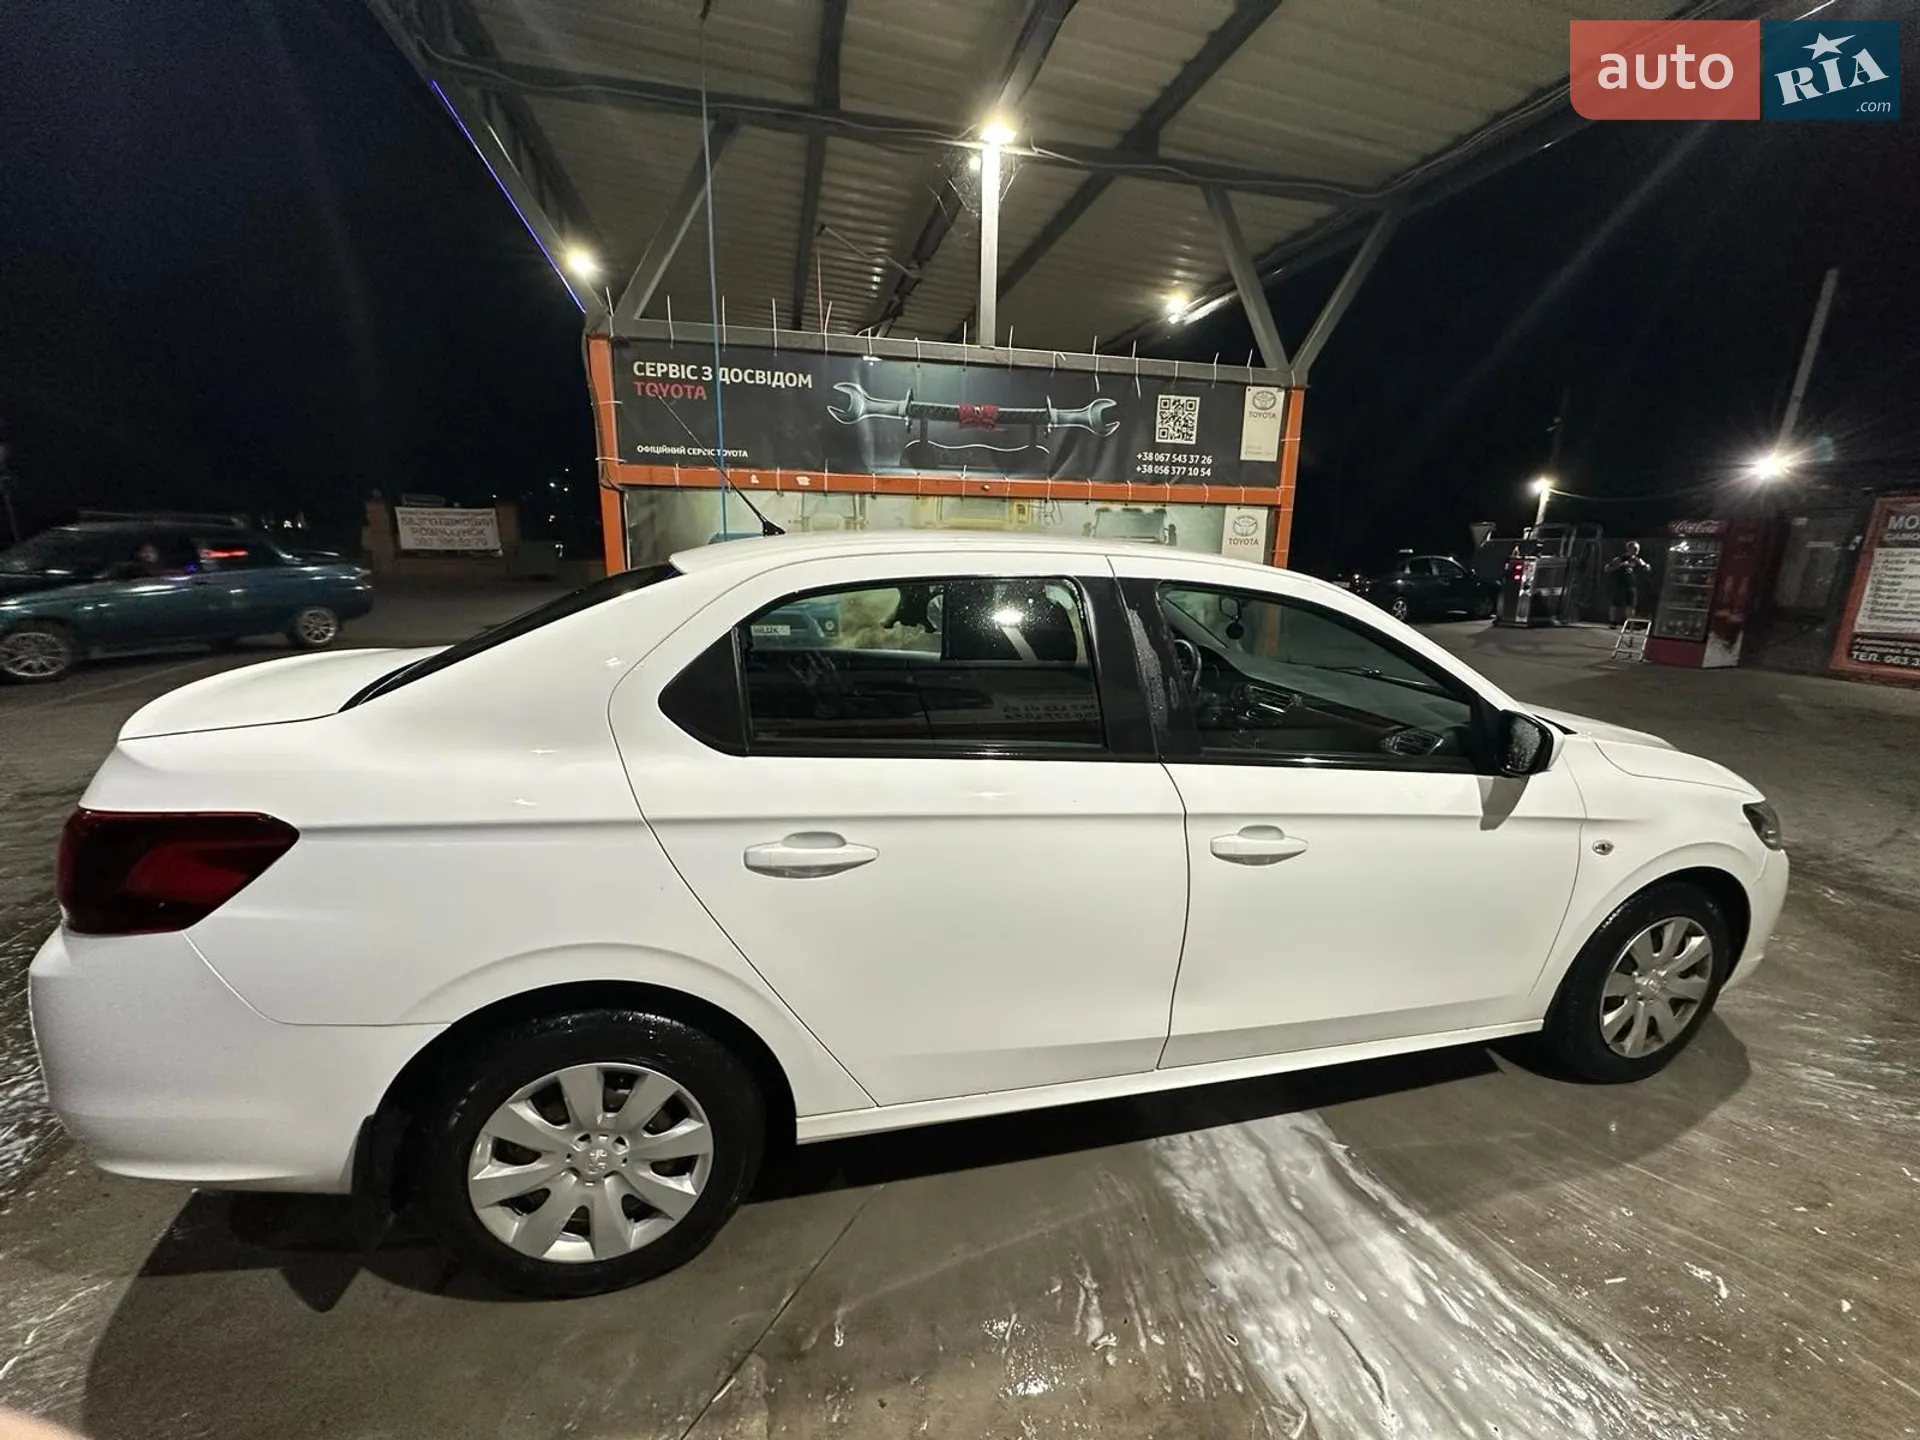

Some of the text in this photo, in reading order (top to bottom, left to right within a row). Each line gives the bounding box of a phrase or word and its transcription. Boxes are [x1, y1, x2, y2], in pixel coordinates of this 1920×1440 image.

[632, 360, 698, 381] СЕРВІС
[718, 367, 813, 389] ДОСВІДОМ
[633, 381, 708, 401] TOYOTA
[1248, 411, 1277, 420] TOYOTA
[636, 444, 687, 456] ОФІЦІЙНИЙ
[1136, 451, 1213, 466] +38 067 543 37 26
[1136, 464, 1212, 478] +38 056 377 10 54
[1887, 514, 1920, 530] МО
[1228, 537, 1259, 546] TOYOTA
